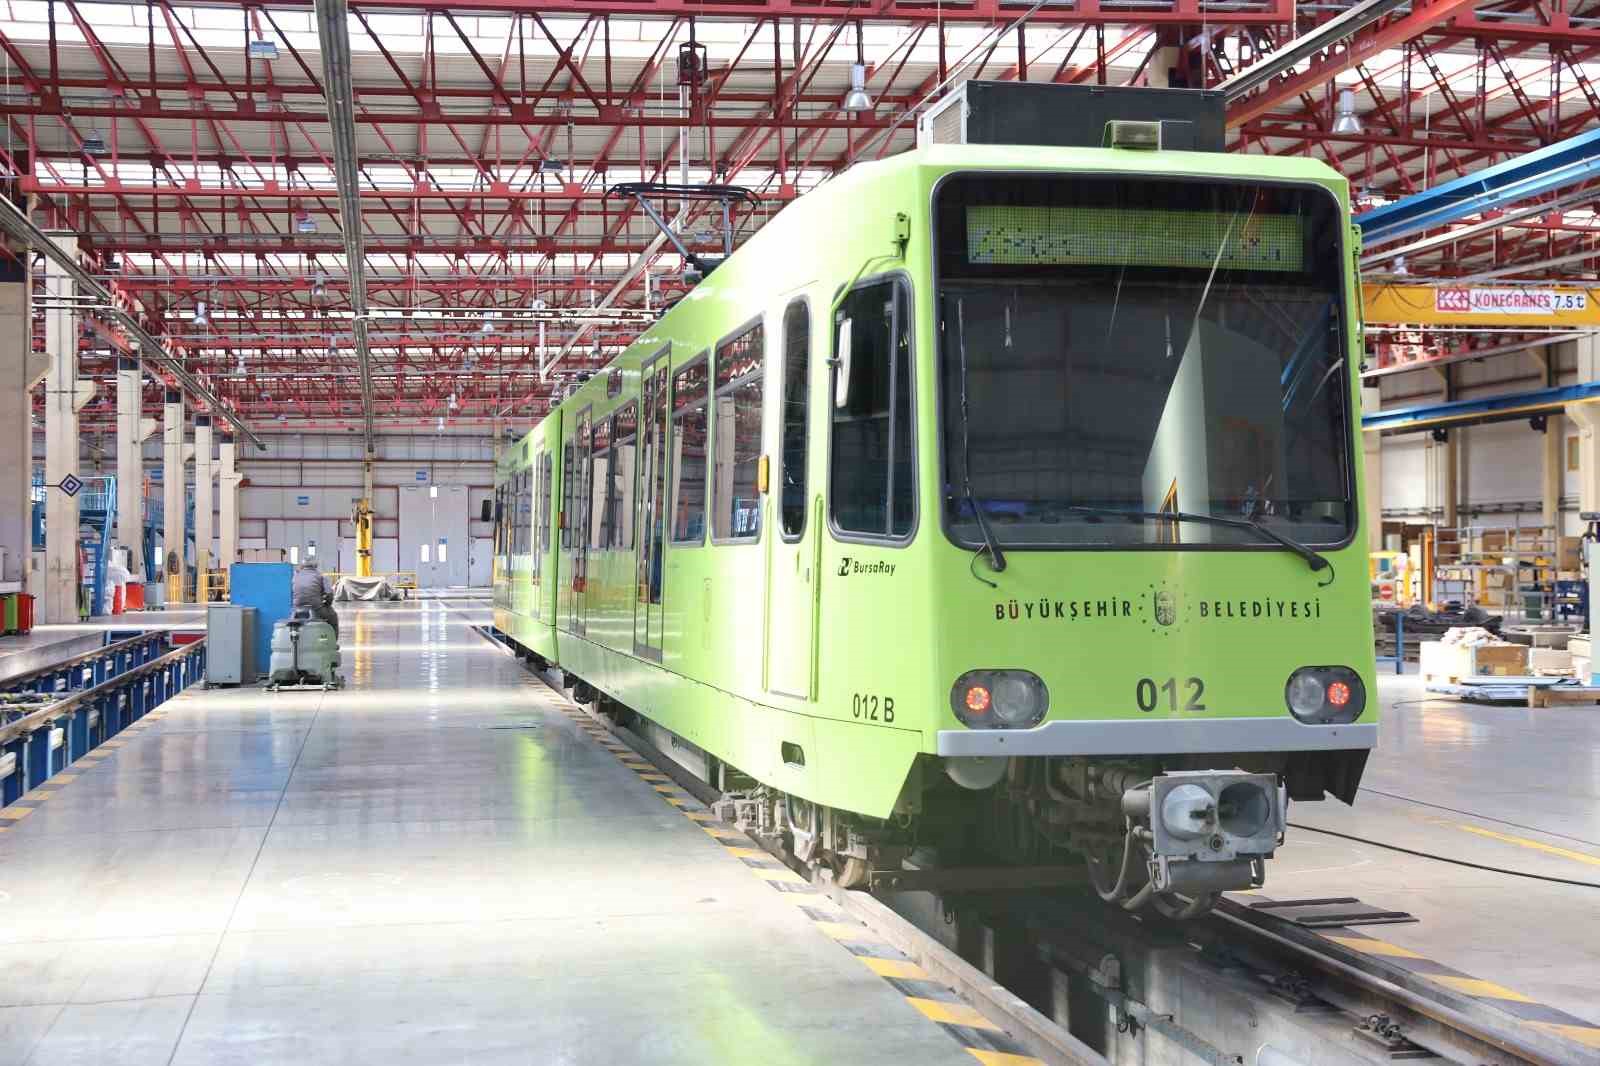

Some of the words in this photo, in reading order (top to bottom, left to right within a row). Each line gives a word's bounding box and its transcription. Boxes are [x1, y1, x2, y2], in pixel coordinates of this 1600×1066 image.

[1475, 293, 1551, 307] KONECRANES
[853, 560, 896, 576] BursaRay
[995, 596, 1131, 621] BÜYÜKŞEHİR
[1199, 597, 1320, 617] BELEDİYESİ
[1136, 677, 1206, 712] 012
[853, 693, 878, 720] 012
[884, 696, 894, 722] B
